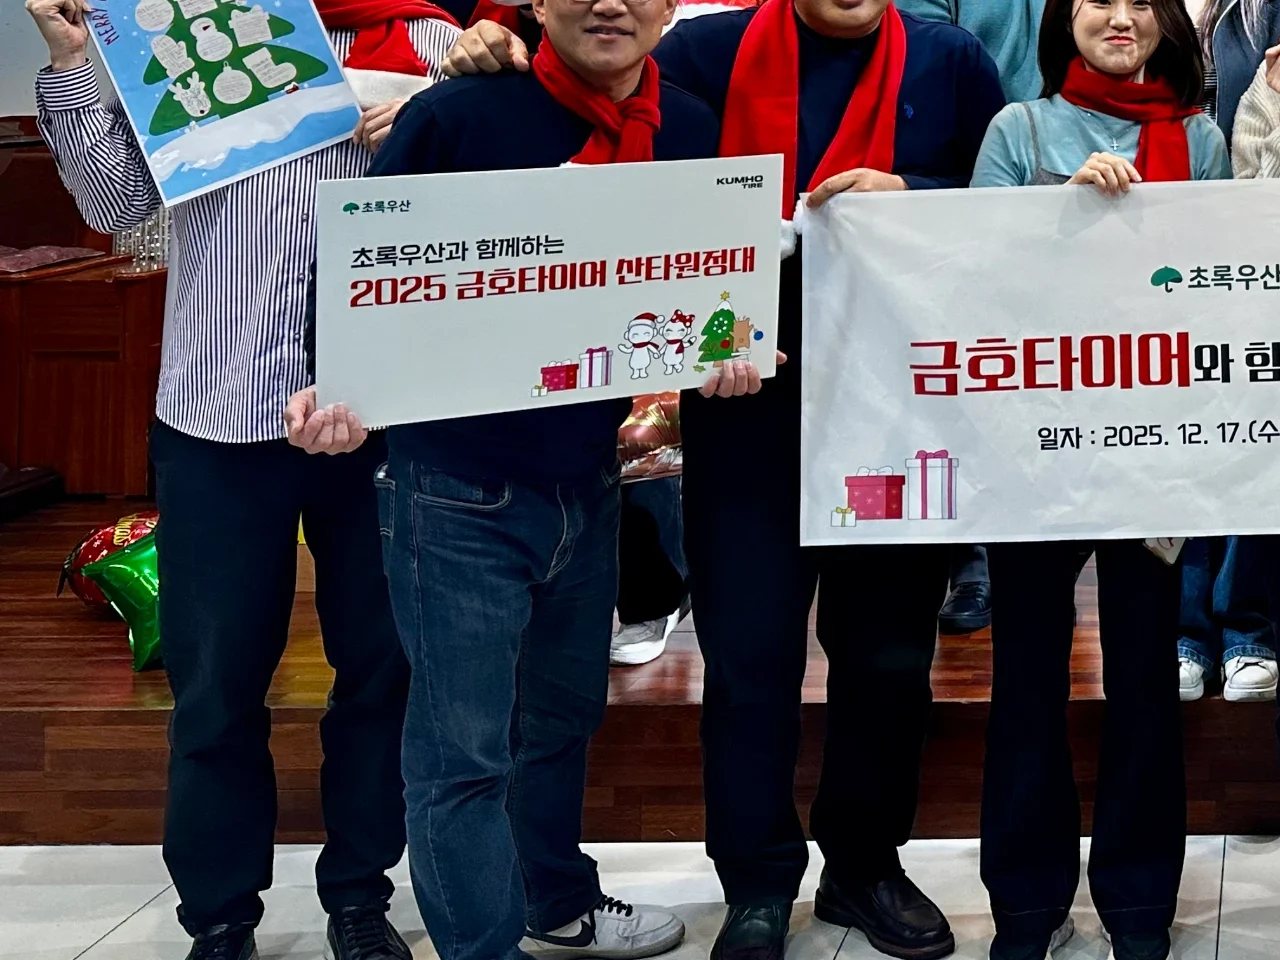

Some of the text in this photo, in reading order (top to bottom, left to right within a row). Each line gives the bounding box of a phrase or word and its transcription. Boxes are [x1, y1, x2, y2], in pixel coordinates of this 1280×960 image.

[92, 7, 120, 45] MERRY
[716, 175, 763, 185] KUMHO
[361, 199, 411, 214] 초록우산
[351, 235, 565, 268] 초록우산과 함께하는
[350, 246, 756, 307] 2025 금호타이어 산타원정대
[1037, 426, 1083, 451] 일자
[1103, 423, 1170, 448] 2025.
[1176, 422, 1209, 446] 12.
